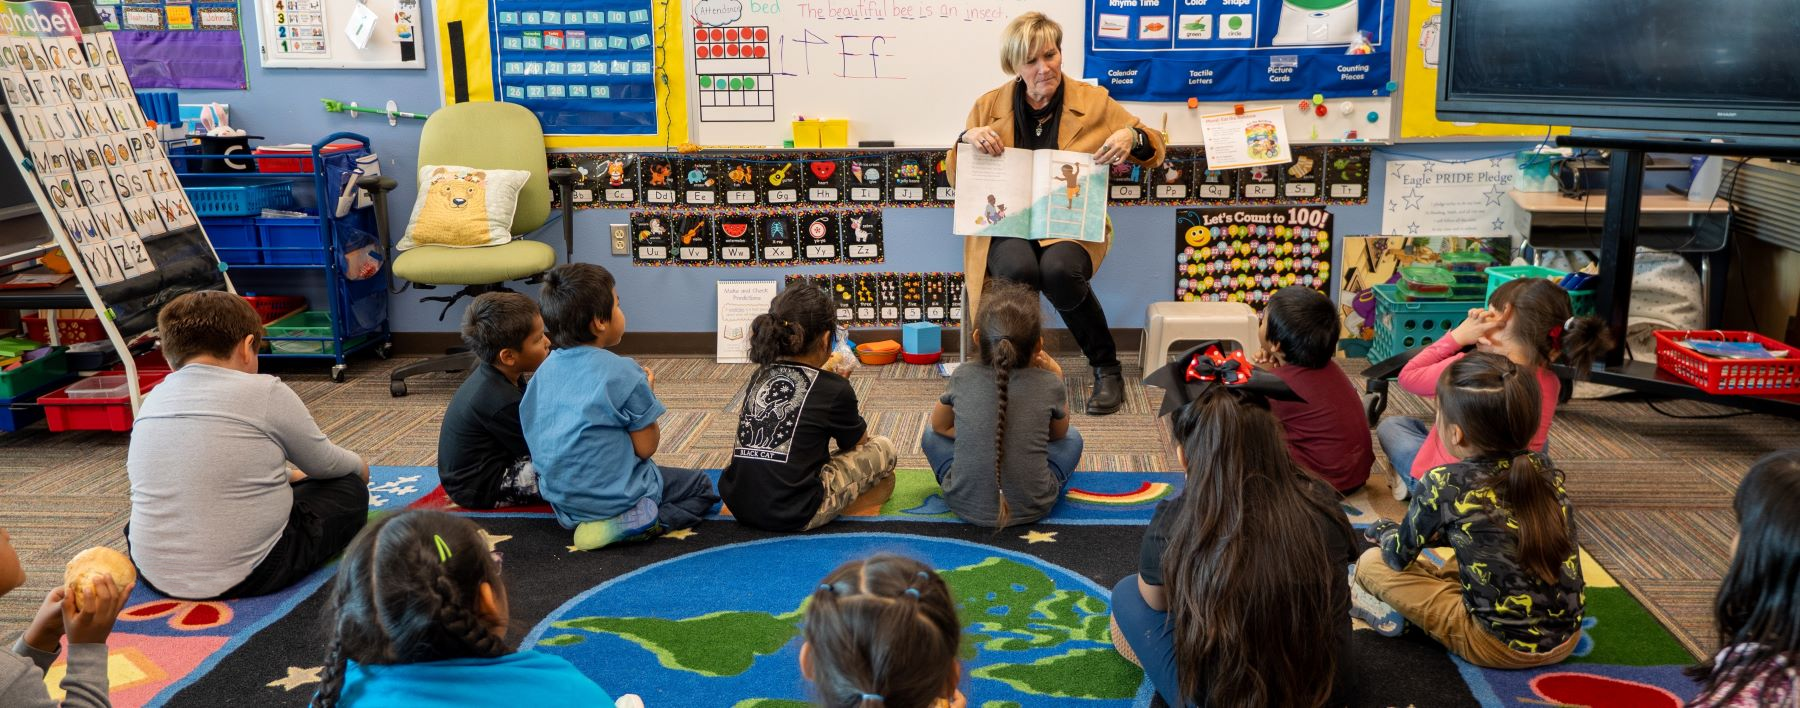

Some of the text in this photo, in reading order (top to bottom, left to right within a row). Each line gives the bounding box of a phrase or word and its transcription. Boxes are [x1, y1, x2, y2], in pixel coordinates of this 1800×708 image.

[798, 4, 825, 18] The
[829, 1, 887, 18] beautiful
[893, 2, 913, 17] bee
[278, 12, 285, 24] 3
[612, 13, 622, 22] 10
[279, 26, 286, 38] 2
[281, 40, 288, 52] 1
[508, 40, 518, 48] 12
[528, 38, 536, 46] 13
[594, 40, 602, 48] 16
[636, 64, 647, 72] 25
[1108, 69, 1138, 77] Calendar
[1337, 64, 1370, 73] Counting
[510, 88, 520, 96] 26
[530, 88, 540, 96] 27
[552, 86, 562, 94] 28
[594, 88, 606, 96] 30
[1403, 171, 1512, 188] Eagle PRIDE Pledge
[1202, 208, 1329, 228] Let's Count to 100!
